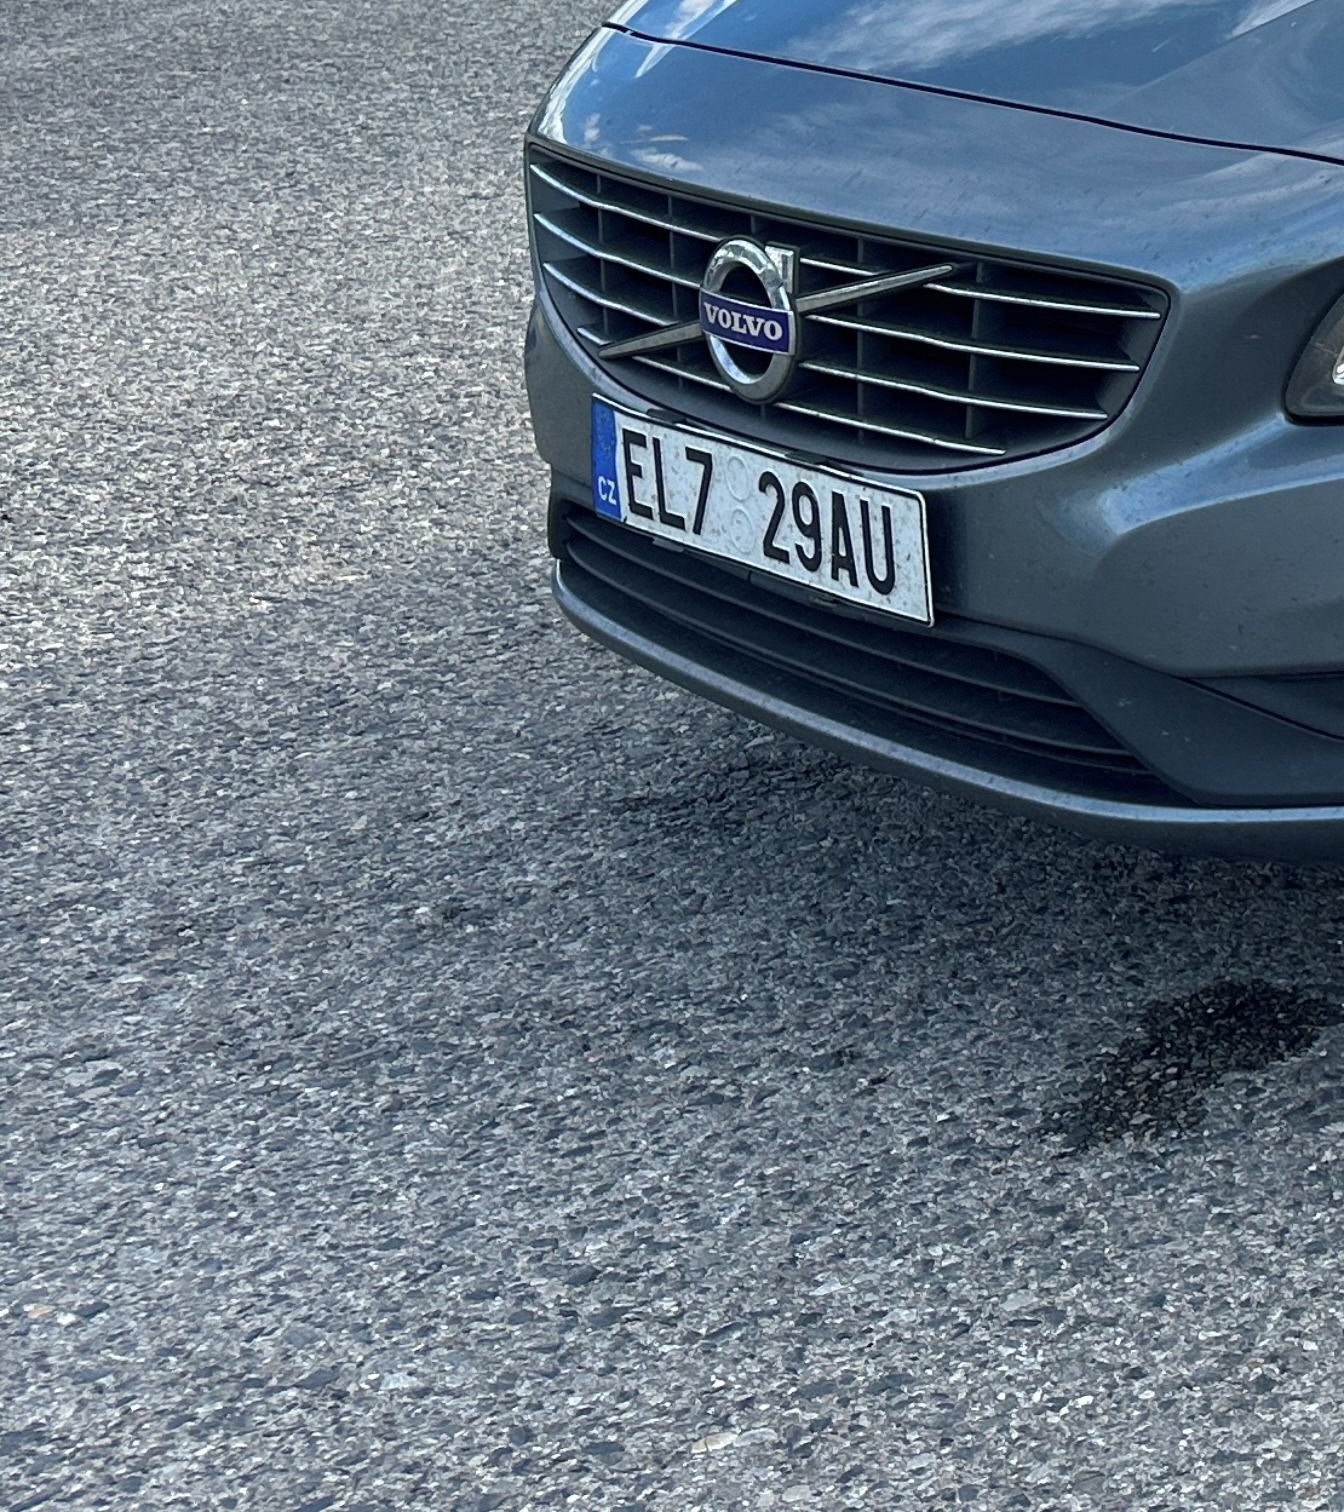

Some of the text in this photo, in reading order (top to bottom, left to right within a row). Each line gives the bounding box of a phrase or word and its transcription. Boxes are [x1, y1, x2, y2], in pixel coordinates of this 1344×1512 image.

[703, 301, 783, 341] VOLVO
[598, 427, 896, 595] CZ EL7 29AU
